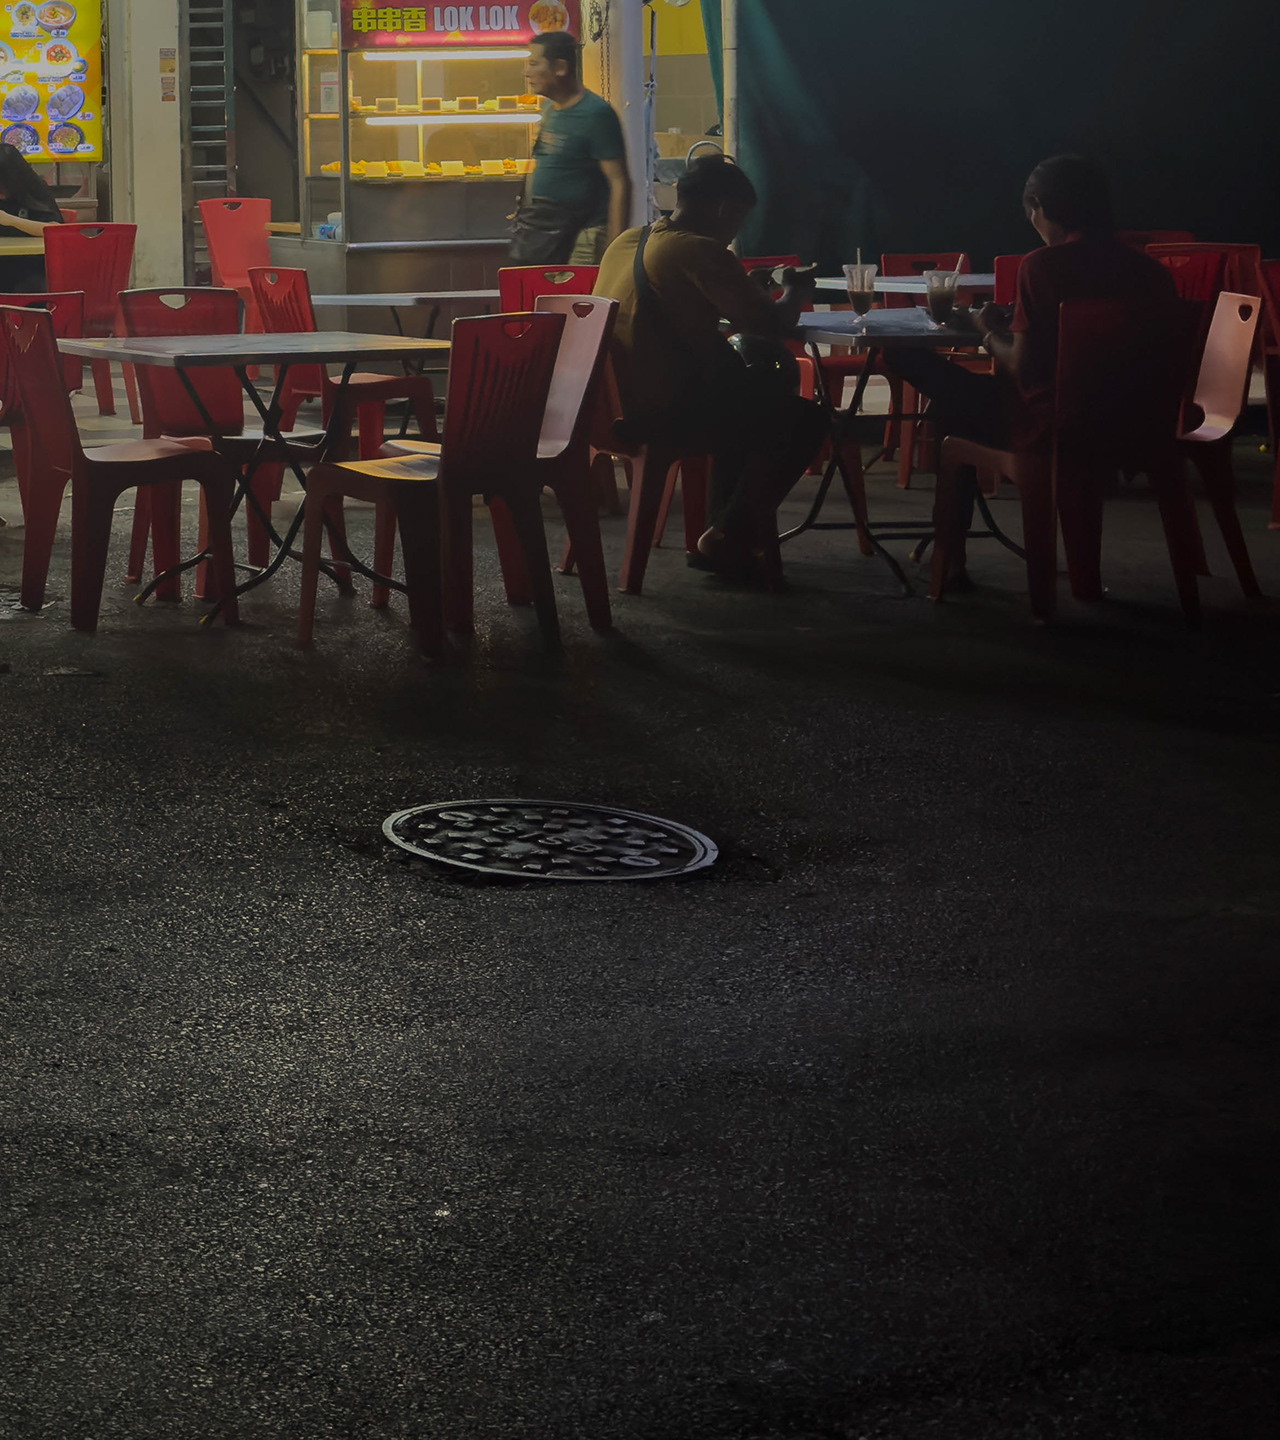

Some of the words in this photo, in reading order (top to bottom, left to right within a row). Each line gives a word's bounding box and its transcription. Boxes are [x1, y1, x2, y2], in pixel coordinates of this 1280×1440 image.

[351, 6, 428, 33] 串串香
[433, 6, 475, 32] LOK
[478, 5, 521, 31] LOK
